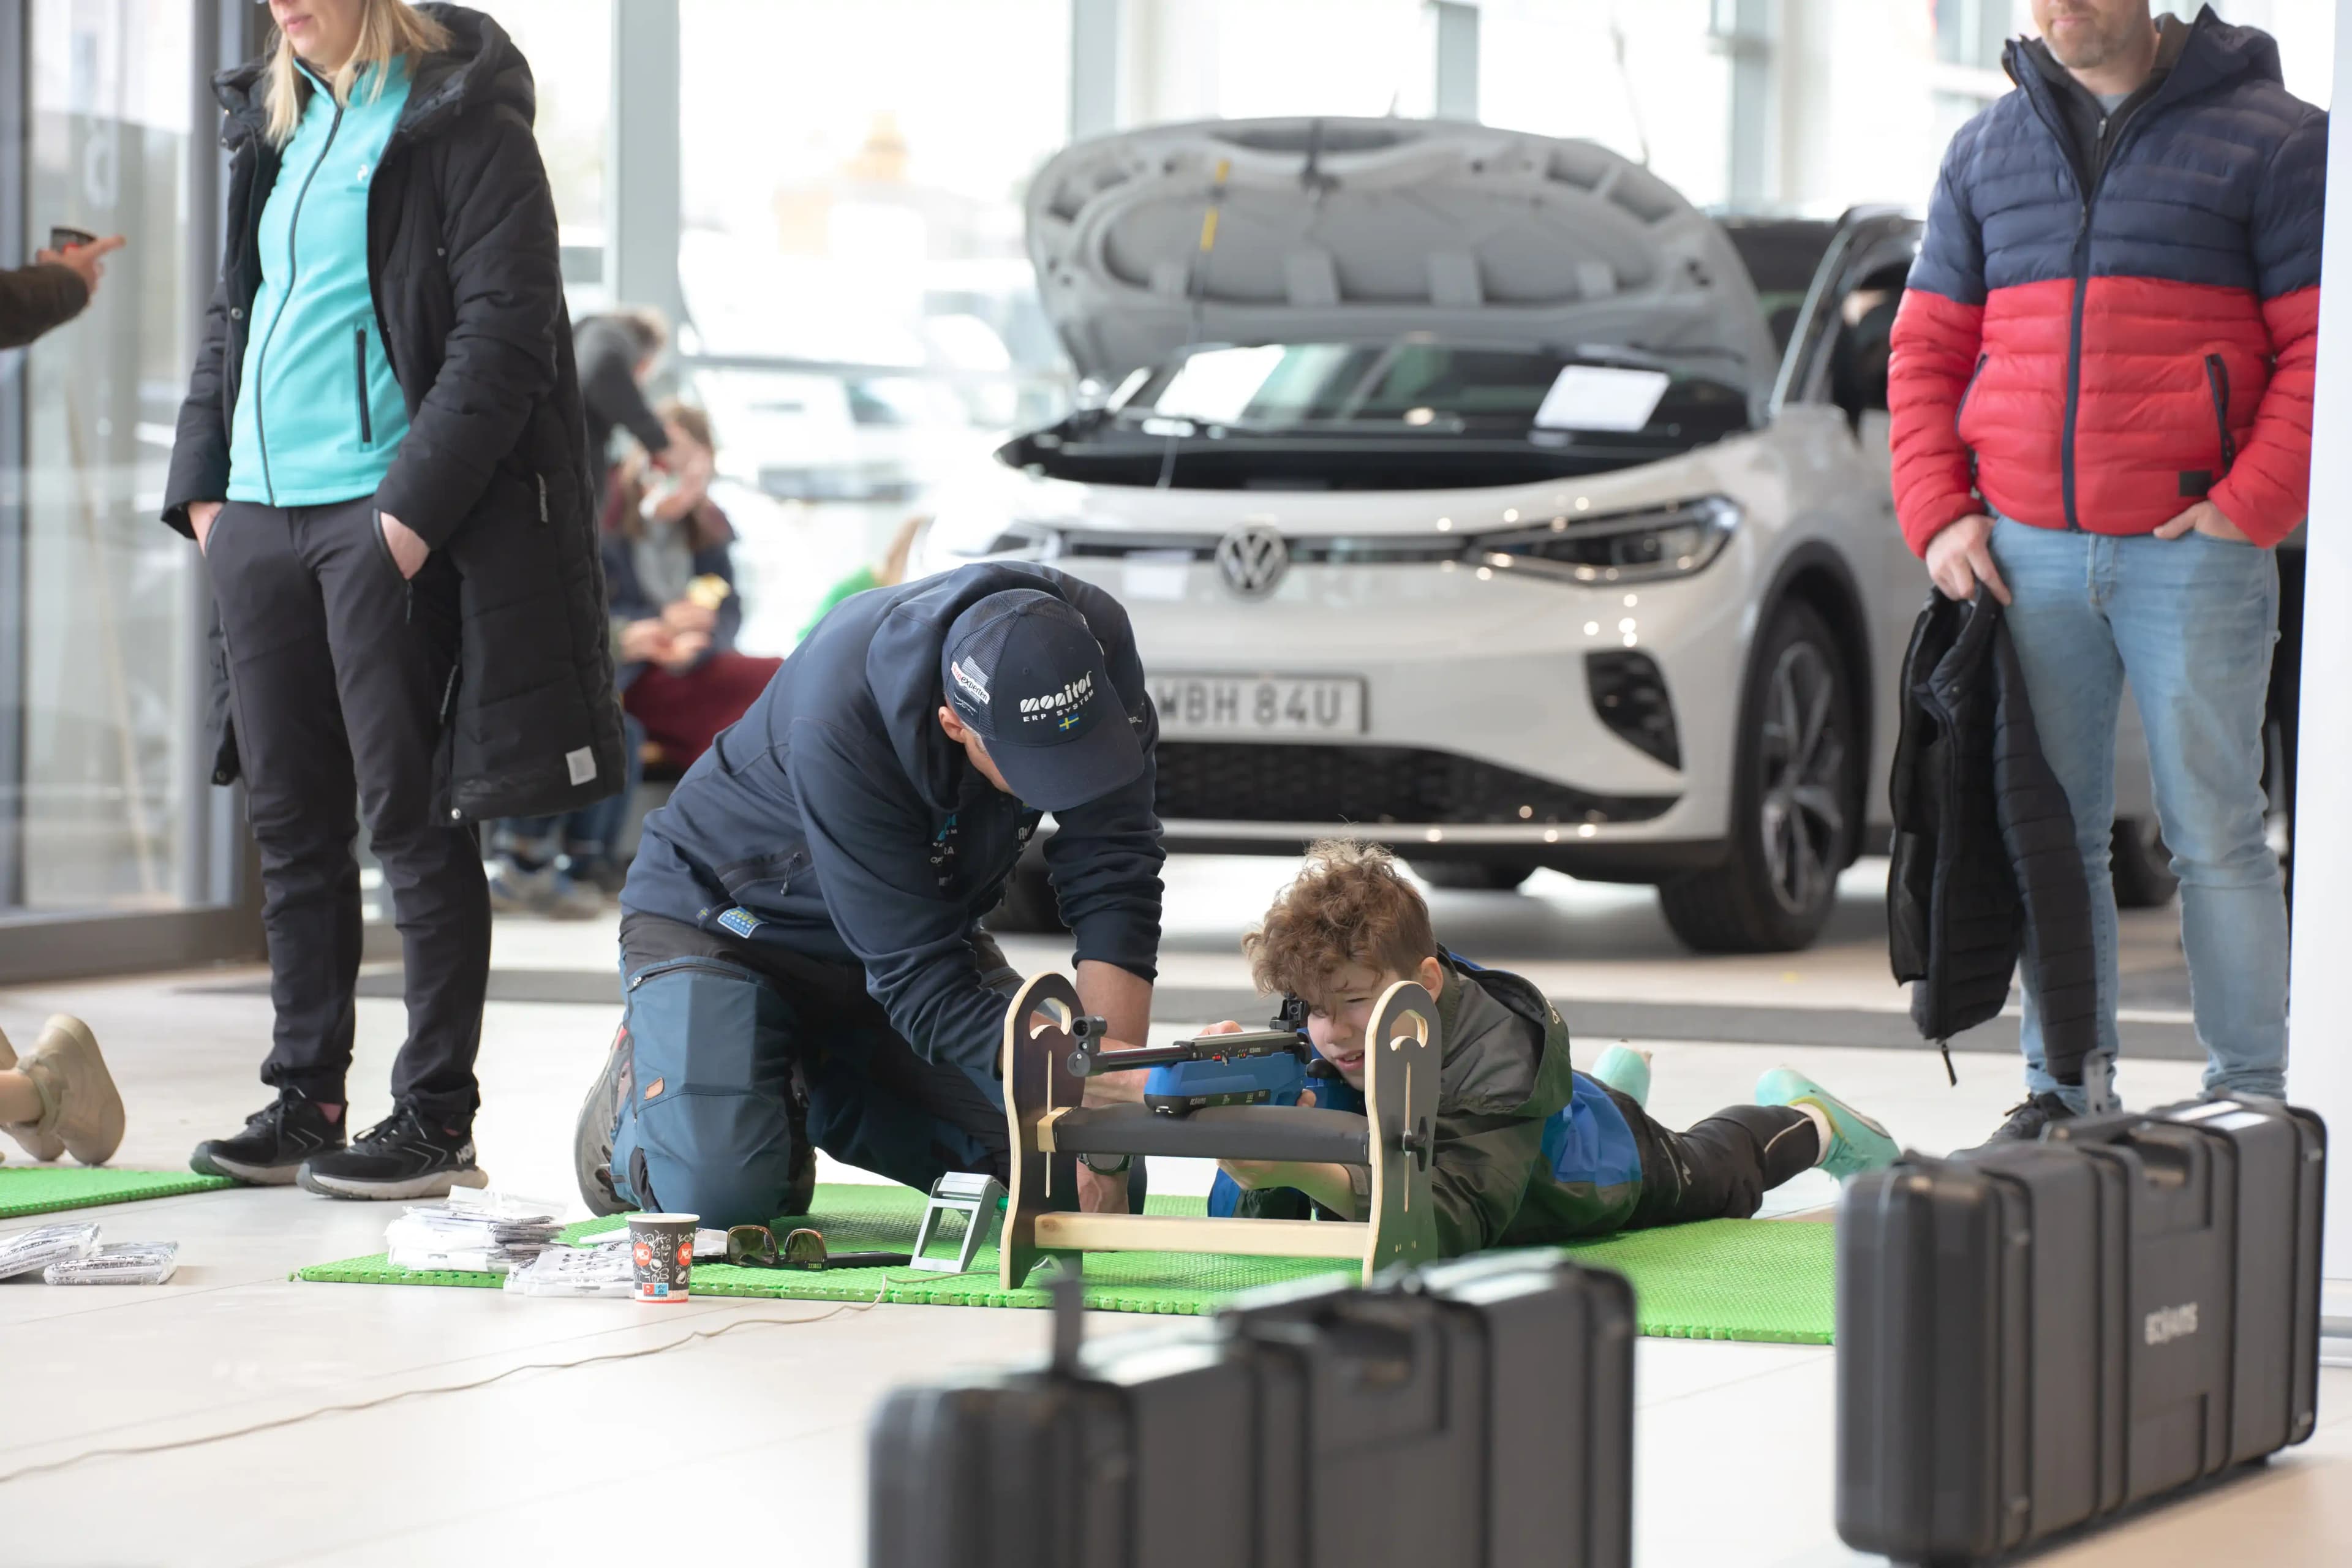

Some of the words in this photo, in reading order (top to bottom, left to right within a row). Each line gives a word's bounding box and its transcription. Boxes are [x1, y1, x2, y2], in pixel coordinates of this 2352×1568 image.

[1020, 671, 1091, 713] monitor
[1023, 713, 1047, 722] ERP
[1056, 688, 1094, 716] SYSTEM
[1256, 683, 1341, 726] 84U
